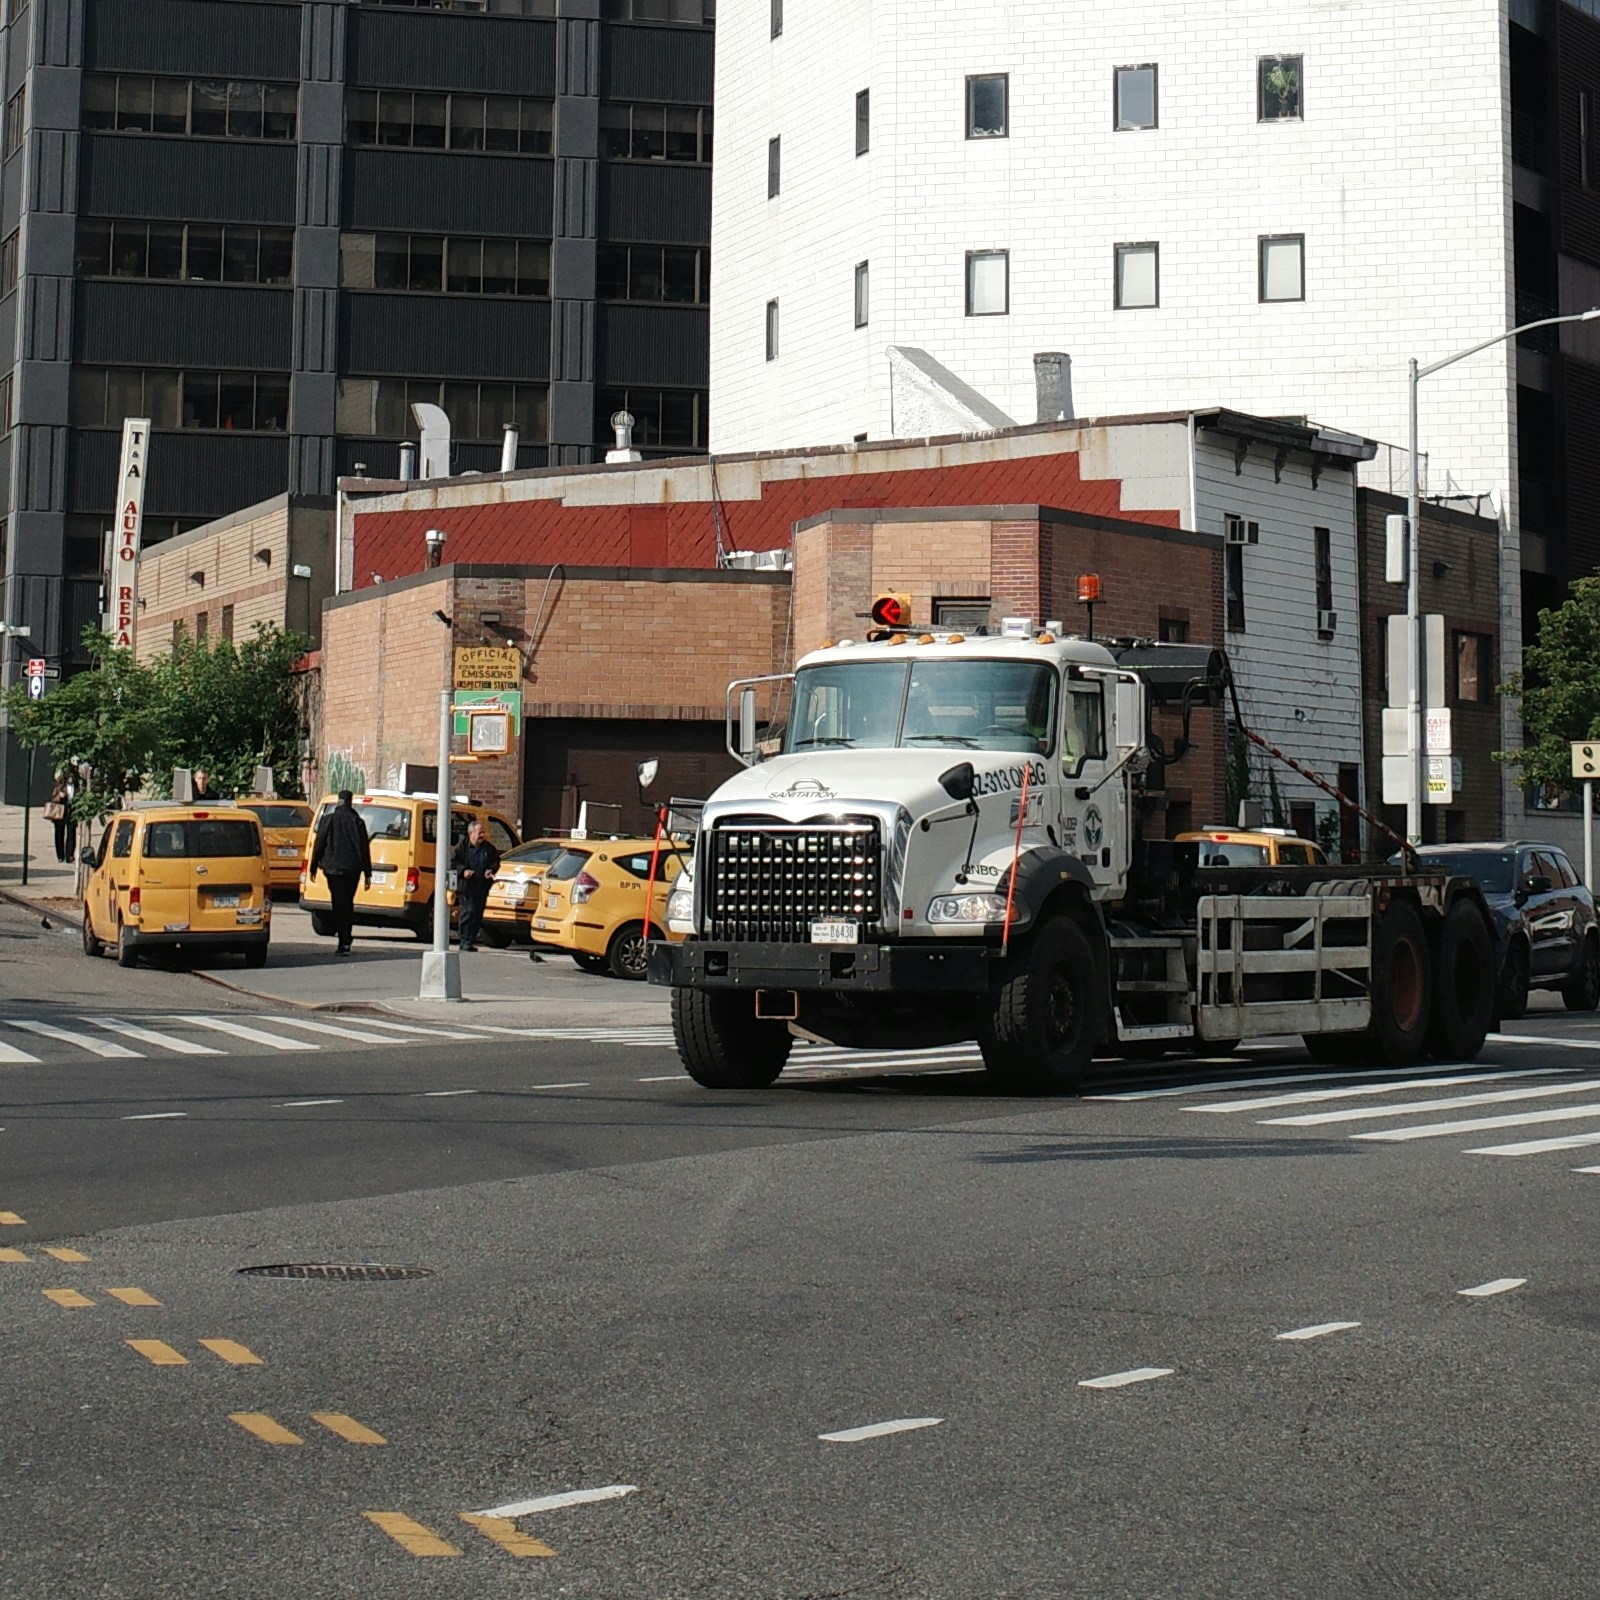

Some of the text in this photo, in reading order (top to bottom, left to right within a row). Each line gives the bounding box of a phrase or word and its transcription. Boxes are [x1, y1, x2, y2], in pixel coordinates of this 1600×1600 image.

[131, 431, 144, 445] T
[127, 463, 141, 478] A
[120, 500, 138, 562] AUTO
[117, 586, 132, 646] REPA
[462, 650, 515, 663] OFFICIAL
[461, 670, 514, 679] EMISSIONS
[768, 791, 839, 799] SANITATION
